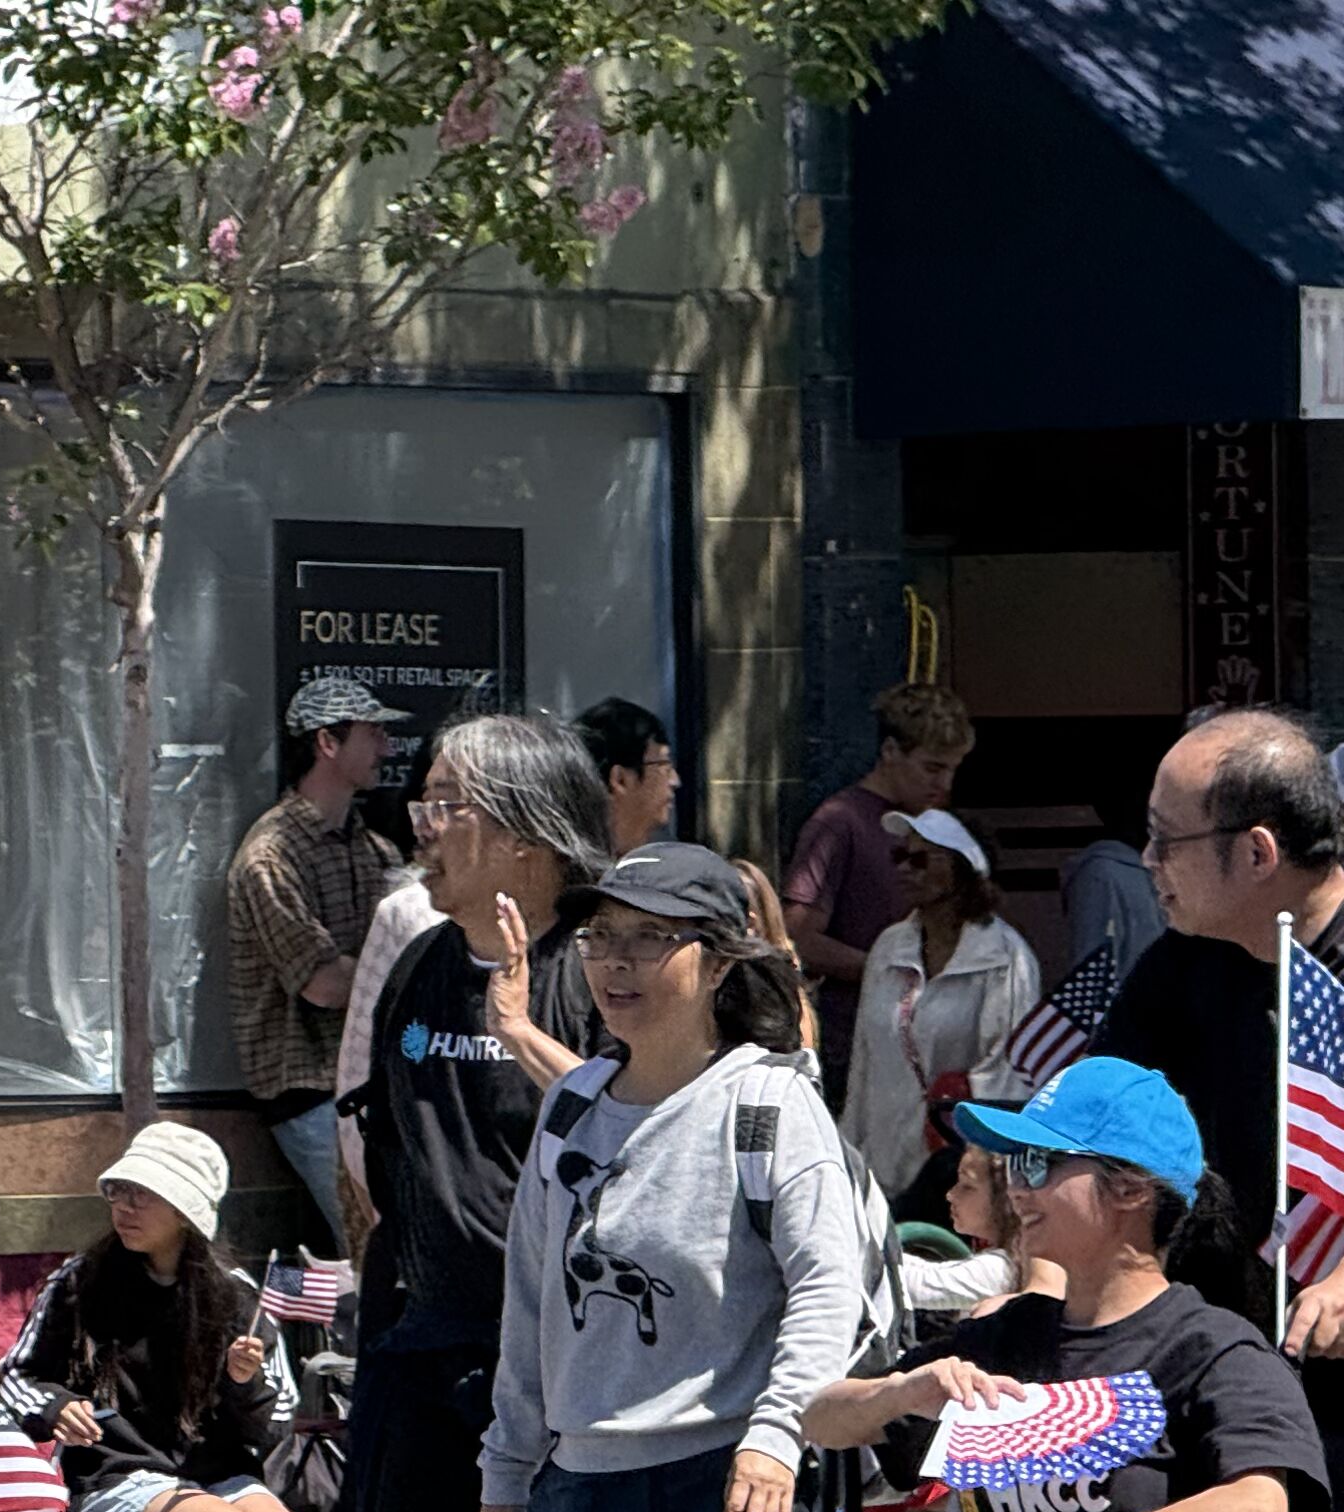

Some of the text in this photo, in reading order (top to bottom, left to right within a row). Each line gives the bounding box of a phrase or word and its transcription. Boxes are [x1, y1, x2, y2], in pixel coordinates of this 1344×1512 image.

[300, 611, 441, 646] FOR LEASE
[397, 667, 444, 687] RETAIL
